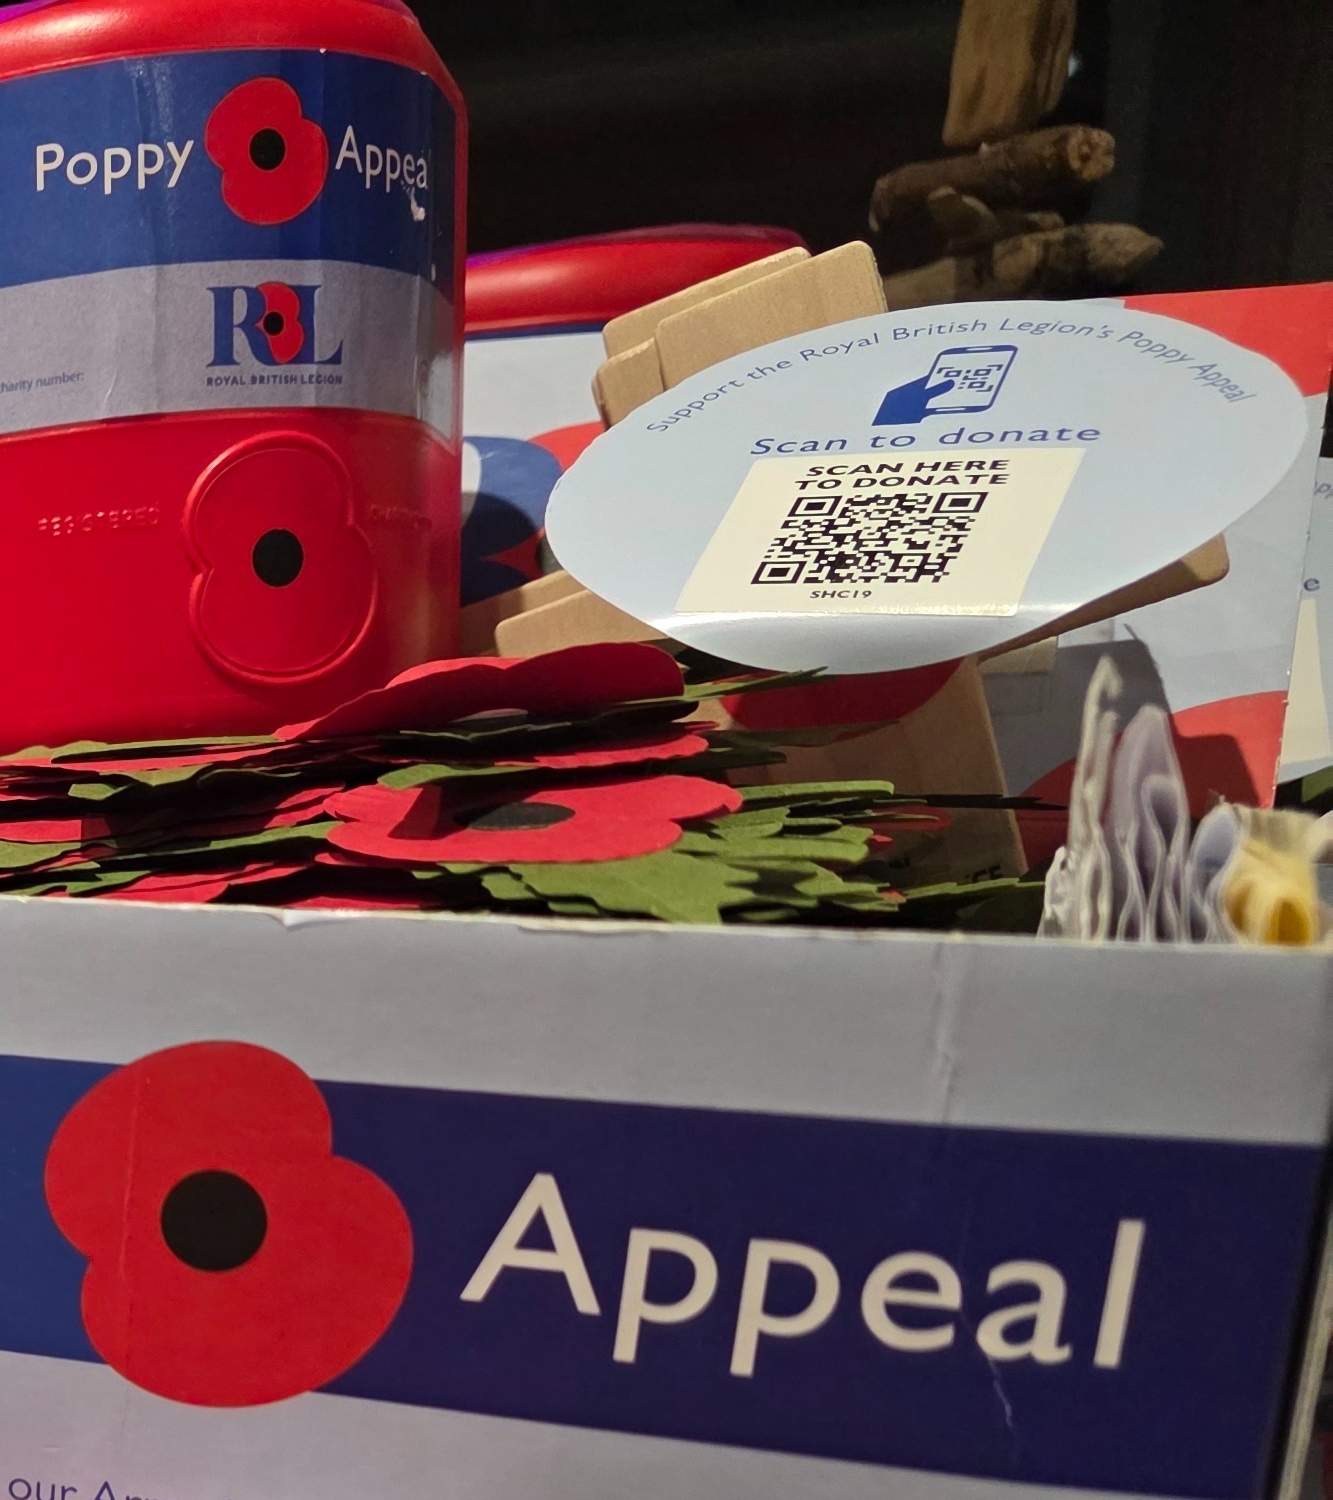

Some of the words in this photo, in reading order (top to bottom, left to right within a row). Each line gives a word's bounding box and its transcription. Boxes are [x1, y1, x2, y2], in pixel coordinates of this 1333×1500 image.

[35, 139, 195, 195] Poppy
[335, 124, 427, 193] Appea
[35, 371, 85, 388] number:
[206, 375, 247, 387] ROYAL
[250, 374, 298, 386] BRITISH
[300, 374, 343, 386] LEGION
[647, 377, 745, 432] Support
[747, 358, 793, 381] the
[799, 332, 880, 362] Royal
[892, 318, 987, 341] British
[999, 317, 1115, 340] Legion's
[1117, 331, 1195, 365] Poppy
[1187, 361, 1258, 403] Appeal
[749, 437, 849, 456] Scan
[870, 434, 917, 449] to
[938, 426, 1102, 447] donate
[805, 461, 905, 477] SCAN
[914, 458, 1012, 473] HERE
[793, 478, 843, 492] TO
[851, 472, 1012, 490] DONATE
[809, 590, 873, 599] SHC19
[459, 1170, 1147, 1379] Appeal
